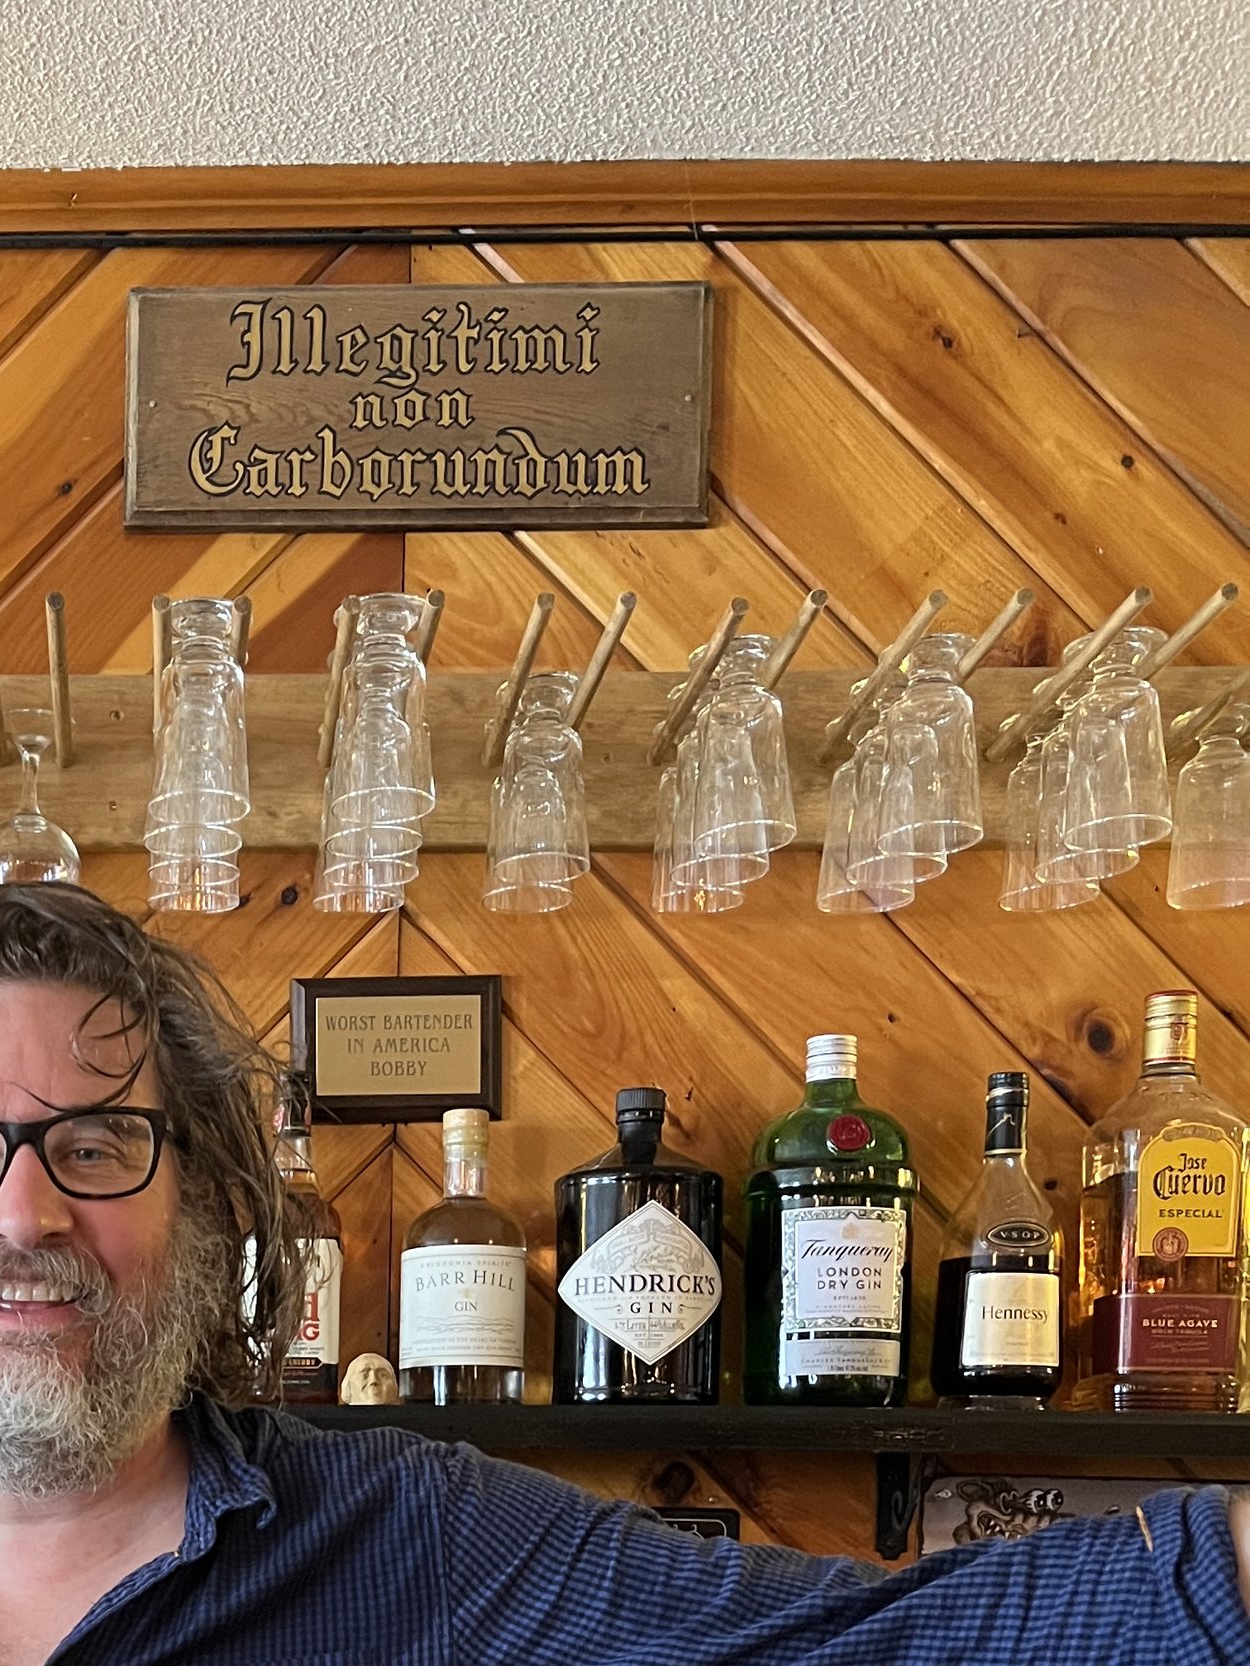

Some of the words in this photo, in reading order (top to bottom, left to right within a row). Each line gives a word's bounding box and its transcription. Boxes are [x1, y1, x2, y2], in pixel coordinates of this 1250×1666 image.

[226, 297, 602, 386] Illegitimi
[350, 386, 475, 431] non
[188, 421, 651, 502] Carborundum
[325, 1015, 377, 1032] WORST
[383, 1013, 473, 1031] BARTENDER
[347, 1038, 364, 1054] IN
[372, 1037, 451, 1054] AMERICA
[370, 1060, 428, 1077] BOBBY
[1178, 1152, 1208, 1173] Jose
[1152, 1165, 1226, 1201] Cuervo
[1158, 1208, 1223, 1218] ESPECIAL
[801, 1239, 894, 1263] Tanqueray
[415, 1271, 465, 1292] BARR
[472, 1269, 515, 1291] HILL
[817, 1266, 883, 1278] LONDON
[575, 1273, 716, 1297] HENDRICK'S
[817, 1280, 849, 1290] DRY
[856, 1280, 883, 1290] GIN
[454, 1301, 478, 1312] GIN
[630, 1302, 673, 1314] GIN
[982, 1305, 1049, 1324] Hennessy
[1142, 1318, 1176, 1328] BLUE
[1177, 1319, 1219, 1328] AGAVE
